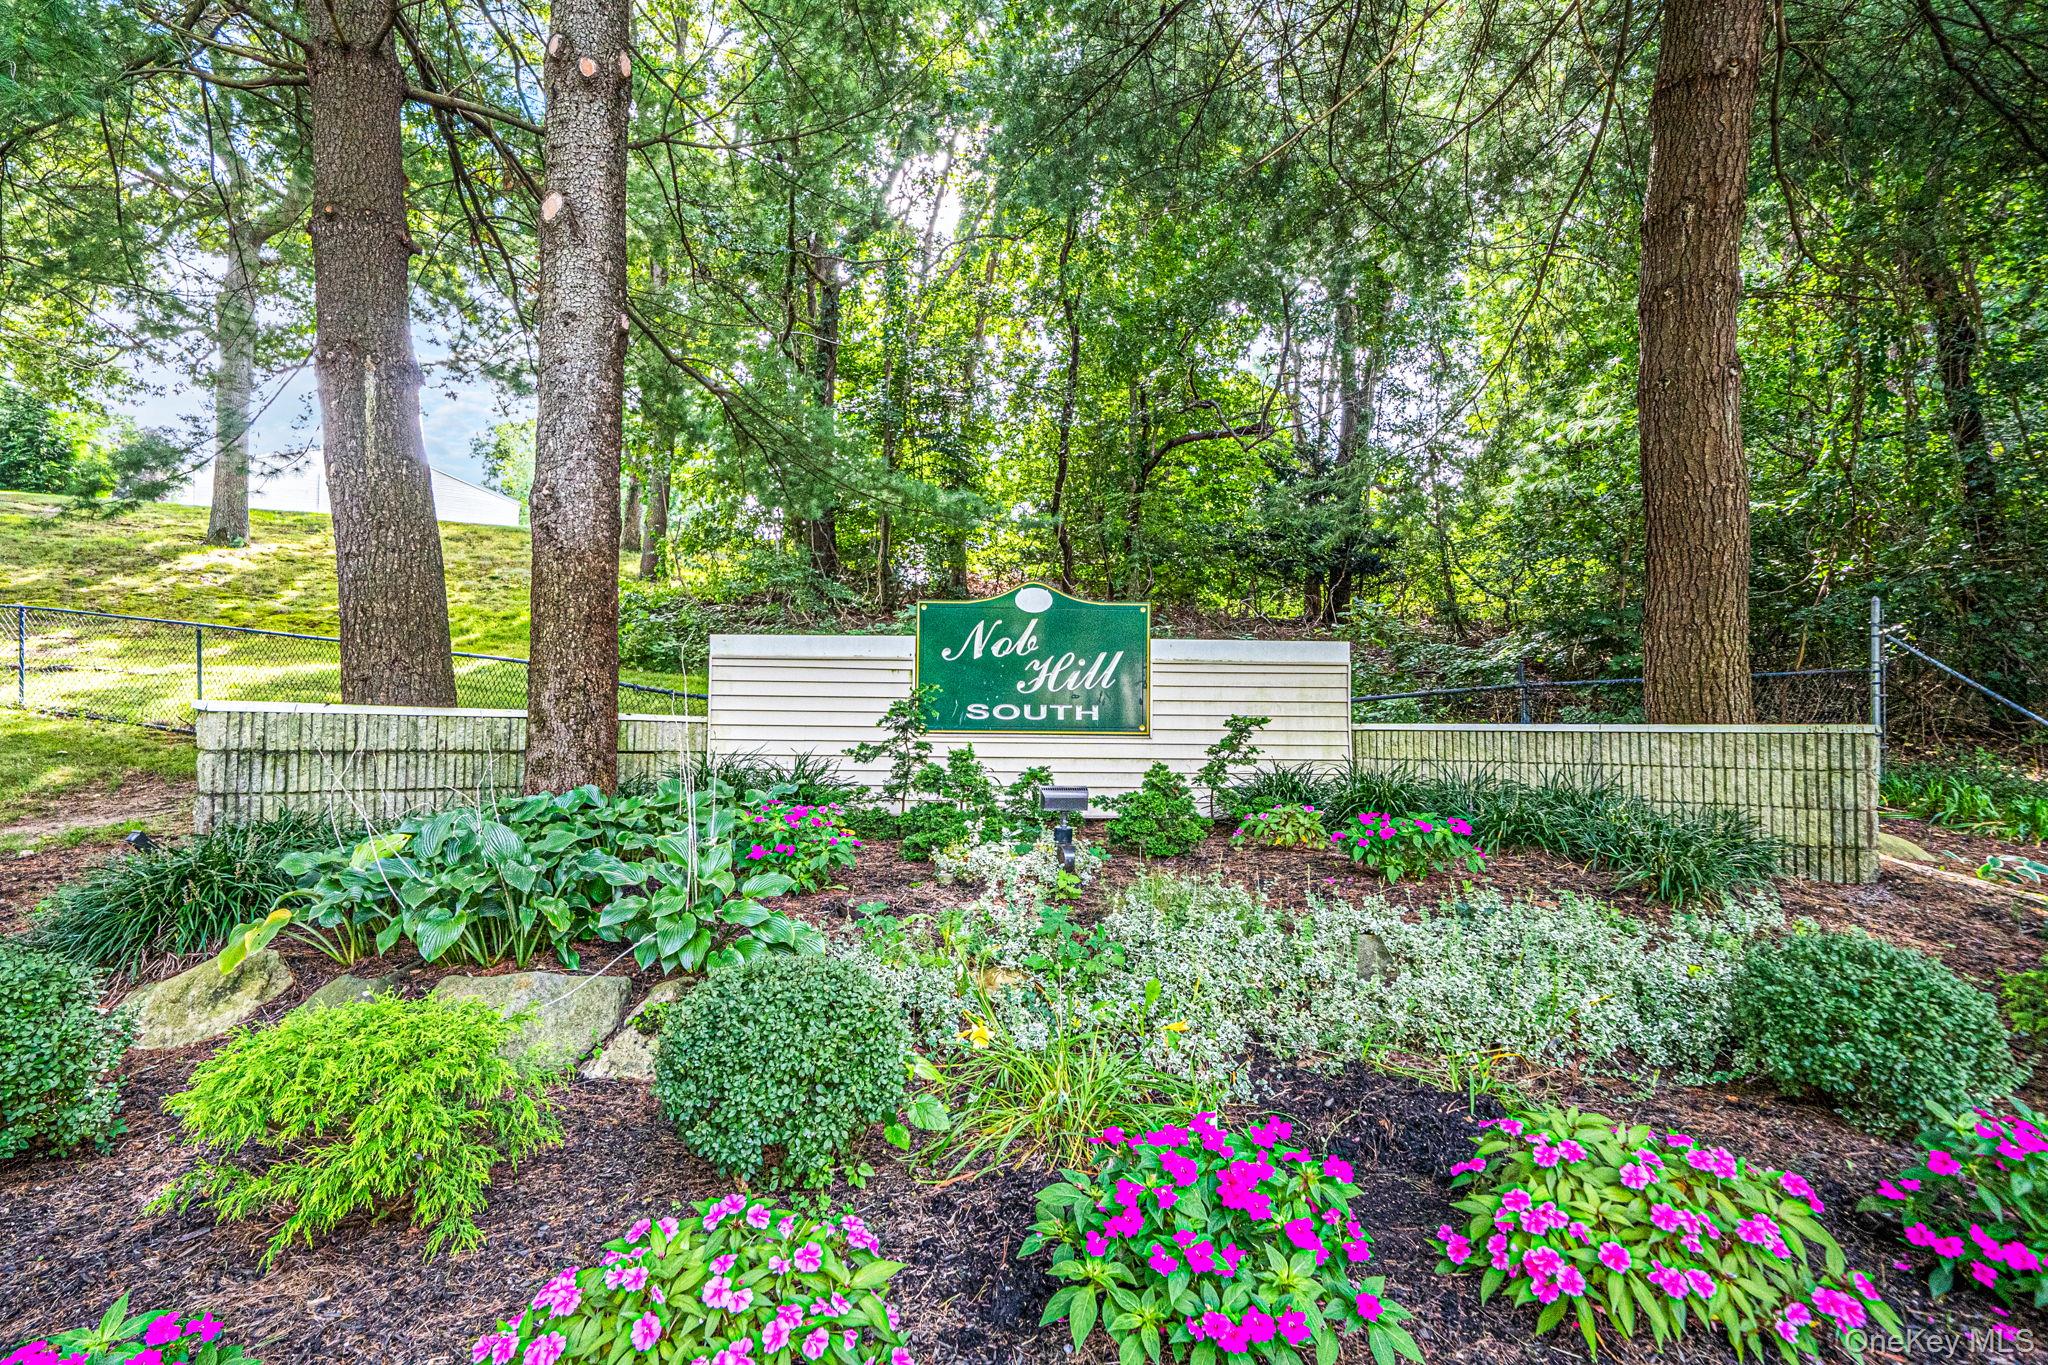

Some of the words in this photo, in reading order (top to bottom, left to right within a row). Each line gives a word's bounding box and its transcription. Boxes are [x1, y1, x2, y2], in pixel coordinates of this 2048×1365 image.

[941, 618, 1039, 661] Nob
[1016, 650, 1124, 694] Hill
[966, 703, 1099, 721] SOUTH
